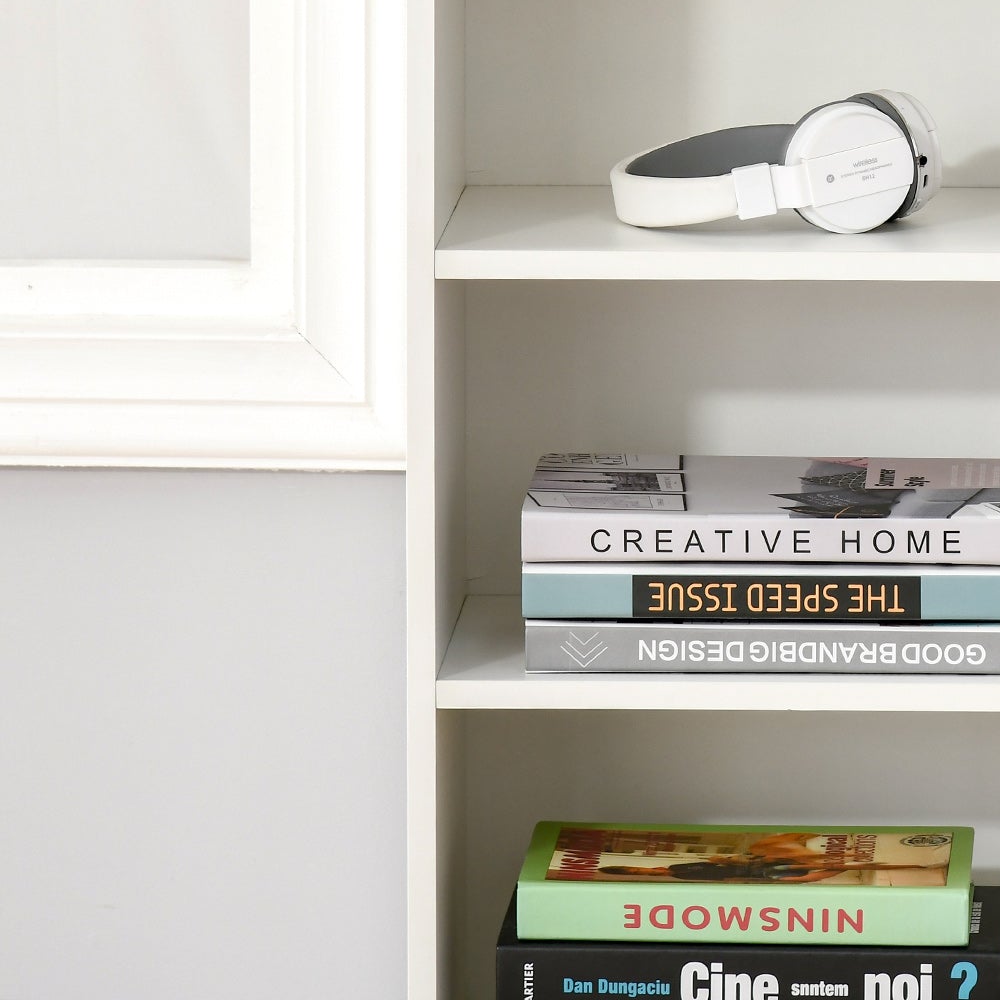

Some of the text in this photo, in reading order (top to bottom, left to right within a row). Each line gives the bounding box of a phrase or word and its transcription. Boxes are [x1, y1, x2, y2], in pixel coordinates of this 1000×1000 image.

[590, 529, 961, 554] CREATIVE HOME
[648, 582, 905, 613] THE SPEED ISSUE
[638, 639, 744, 662] DESIGN
[901, 643, 986, 665] GOOD
[623, 904, 864, 934] NINSMODE
[563, 977, 671, 998] Dan Dungaciu
[680, 961, 779, 1000] Cine
[864, 963, 933, 1000] noi
[950, 961, 978, 1000] ?
